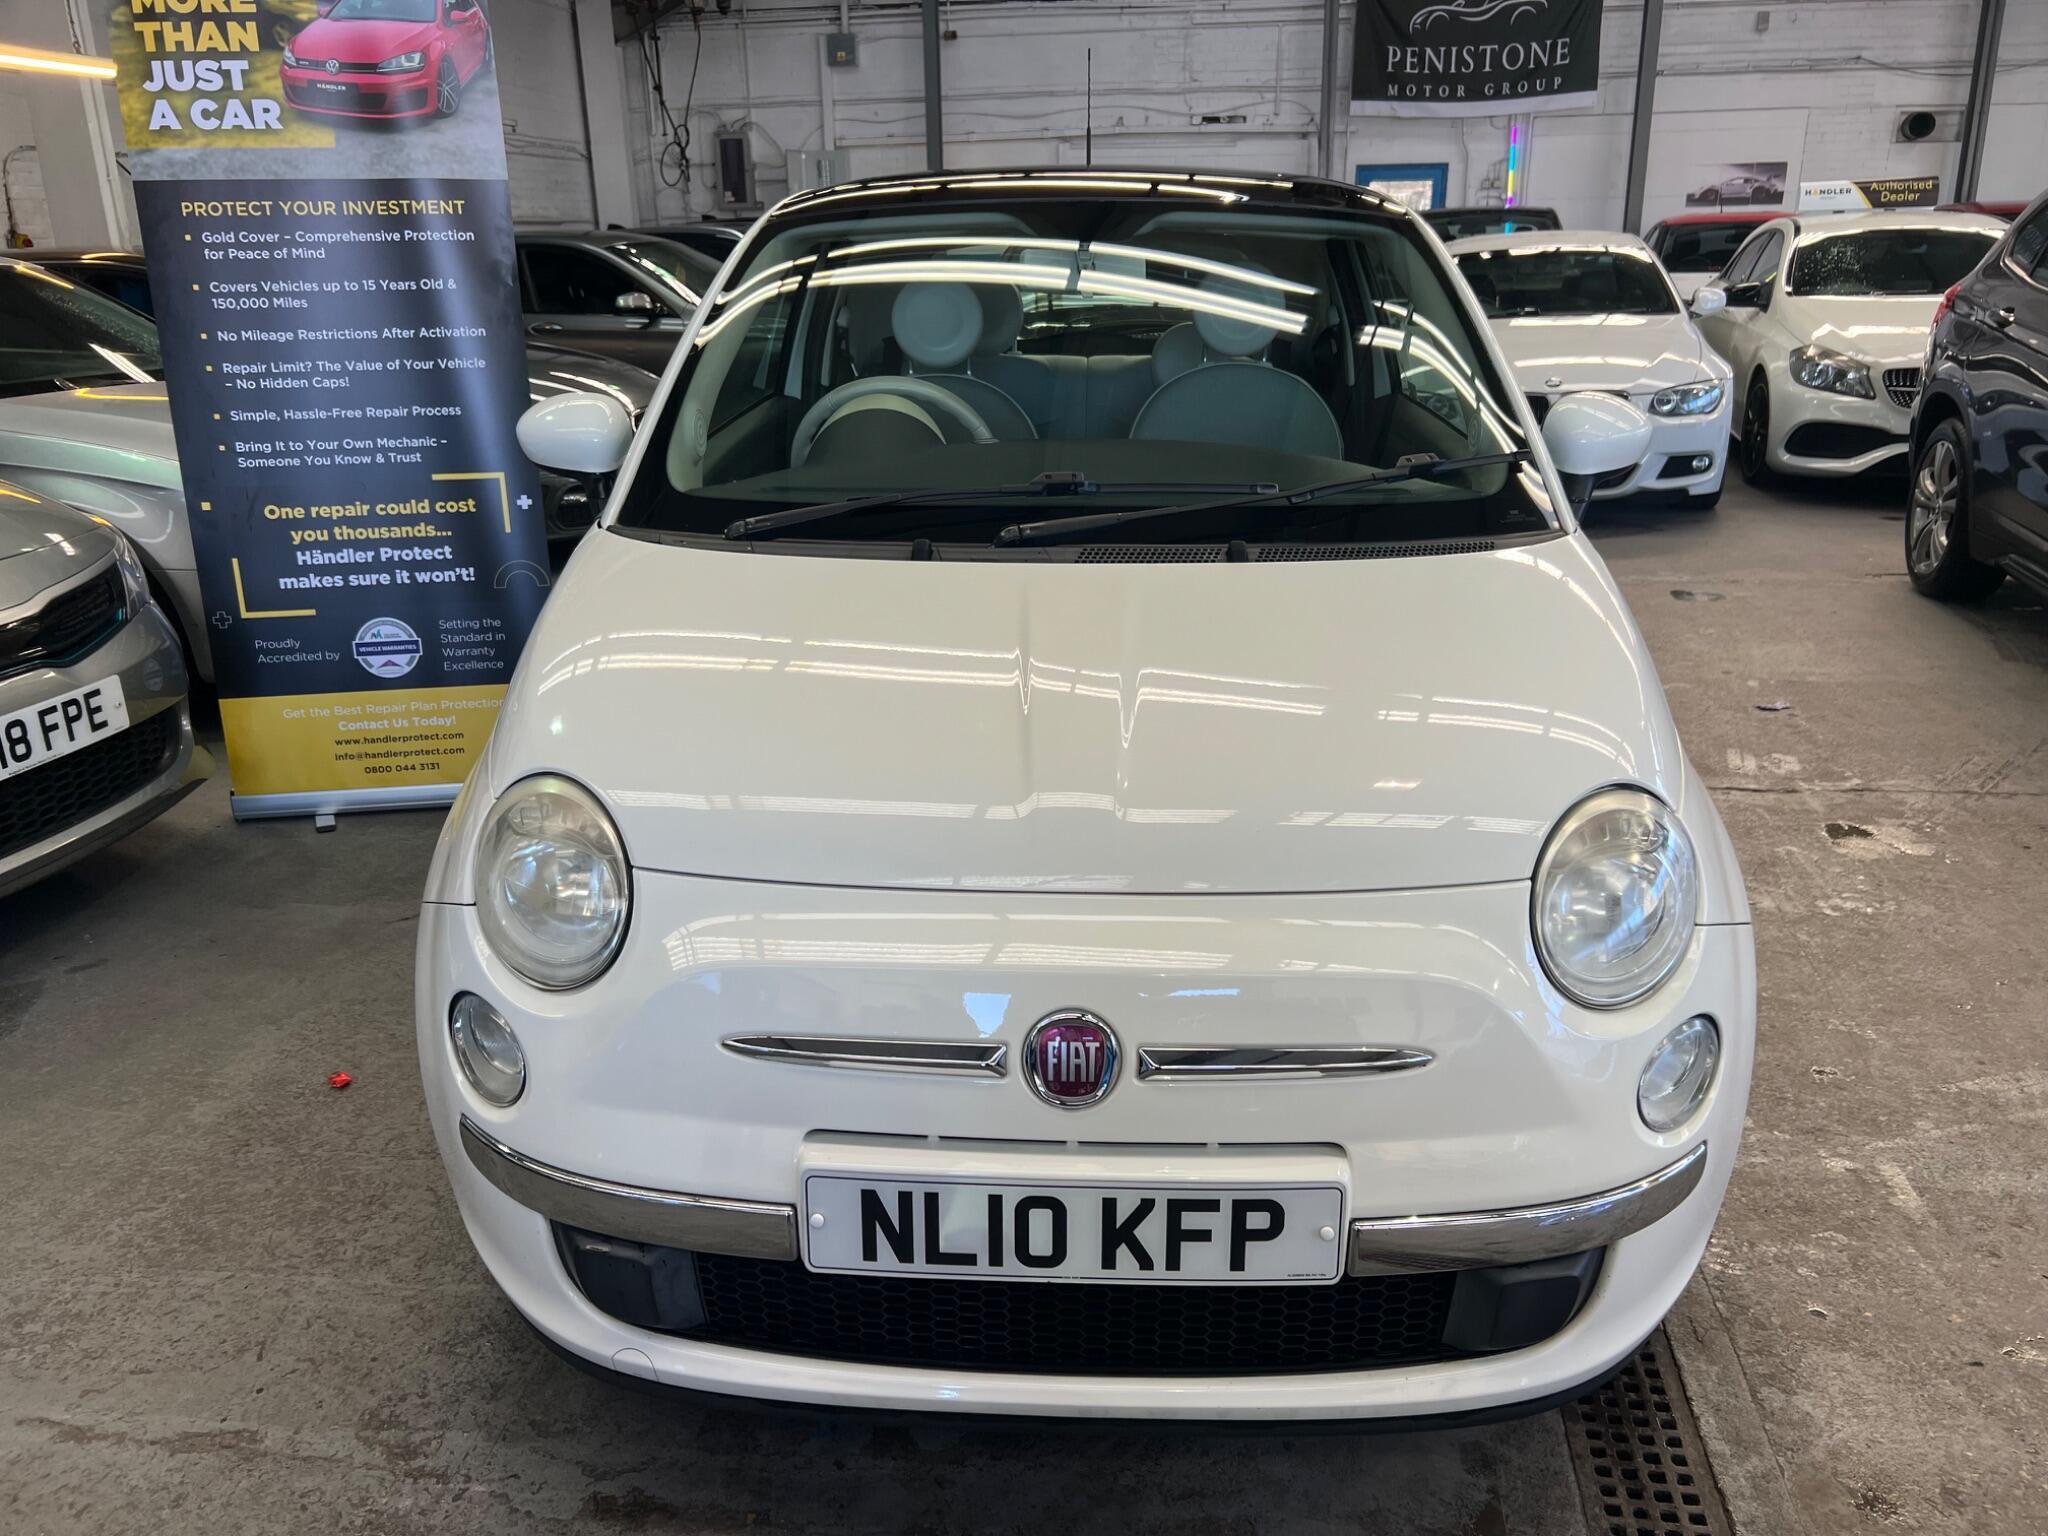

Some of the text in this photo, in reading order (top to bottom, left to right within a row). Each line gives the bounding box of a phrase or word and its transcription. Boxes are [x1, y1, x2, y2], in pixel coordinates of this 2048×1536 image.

[134, 21, 259, 52] THAN
[1386, 38, 1571, 74] PENISTONE
[142, 60, 249, 91] JUST
[1387, 76, 1562, 97] MOTOR GROUP
[149, 99, 283, 130] A CAR
[1870, 180, 1933, 191] Authorised
[1881, 191, 1920, 202] Dealer
[181, 200, 465, 217] PROTECT YOUR INVESTMENT
[202, 231, 235, 244] Gold
[239, 231, 280, 243] Cover
[295, 230, 401, 244] Comprehensive
[404, 229, 475, 242] Protection
[204, 247, 325, 260] for Peace of Mind
[209, 278, 456, 294] Covers Vehicles up to 15 Years Old &
[212, 297, 308, 311] 150,000 Miles
[217, 326, 486, 343] No Mileage Restrictions After Activation
[223, 357, 486, 376] Repair Limit? The Value of Your Vehicle
[237, 378, 256, 390] No
[260, 377, 309, 389] Hidden
[312, 376, 350, 389] Caps!
[230, 405, 461, 423] Simple, Hassle-Free Repair Process
[235, 441, 272, 455] Bring
[276, 441, 286, 452] It
[288, 441, 303, 451] to
[307, 439, 339, 451] Your
[343, 438, 373, 450] Own
[377, 437, 437, 449] Mechanic
[238, 452, 422, 468] Someone You Know & Trust
[264, 498, 476, 520] One repair could cost
[290, 523, 452, 546] you thousands...
[296, 545, 452, 566] Händler Protect
[279, 573, 344, 590] makes
[349, 573, 391, 587] sure
[395, 569, 410, 585] it
[439, 617, 501, 631] Setting the
[255, 638, 300, 650] Proudly
[441, 631, 505, 644] Standard in
[258, 650, 340, 664] Accredited by
[442, 645, 495, 658] Warranty
[444, 660, 504, 671] Excellence
[283, 707, 306, 719] Get
[310, 706, 330, 717] the
[334, 704, 362, 716] Best
[366, 703, 406, 716] Repair
[411, 700, 436, 712] Plan
[38, 688, 108, 751] FPE
[338, 716, 456, 731] Contact Us Today!
[335, 731, 464, 746] www.handlerprotect.com
[335, 746, 464, 762] info@handlerprotect.com
[364, 763, 440, 775] 0800 044 3131
[1047, 1041, 1100, 1082] FIAT
[860, 1188, 1285, 1272] NL10 KFP
